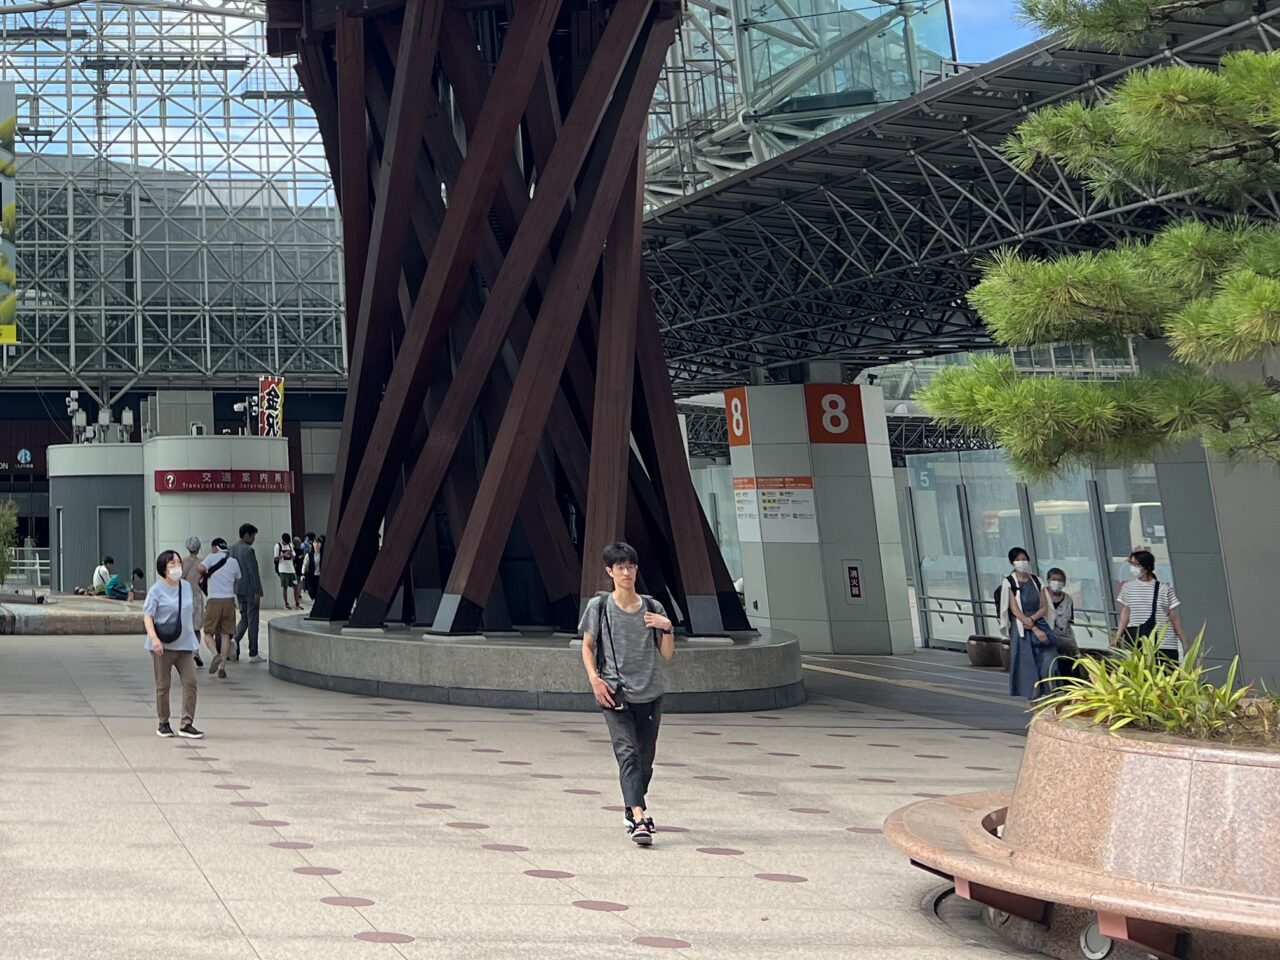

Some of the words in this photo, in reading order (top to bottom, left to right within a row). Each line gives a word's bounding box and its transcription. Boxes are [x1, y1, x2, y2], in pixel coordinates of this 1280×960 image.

[731, 397, 744, 437] 8
[821, 393, 849, 434] 8
[920, 471, 929, 487] 5
